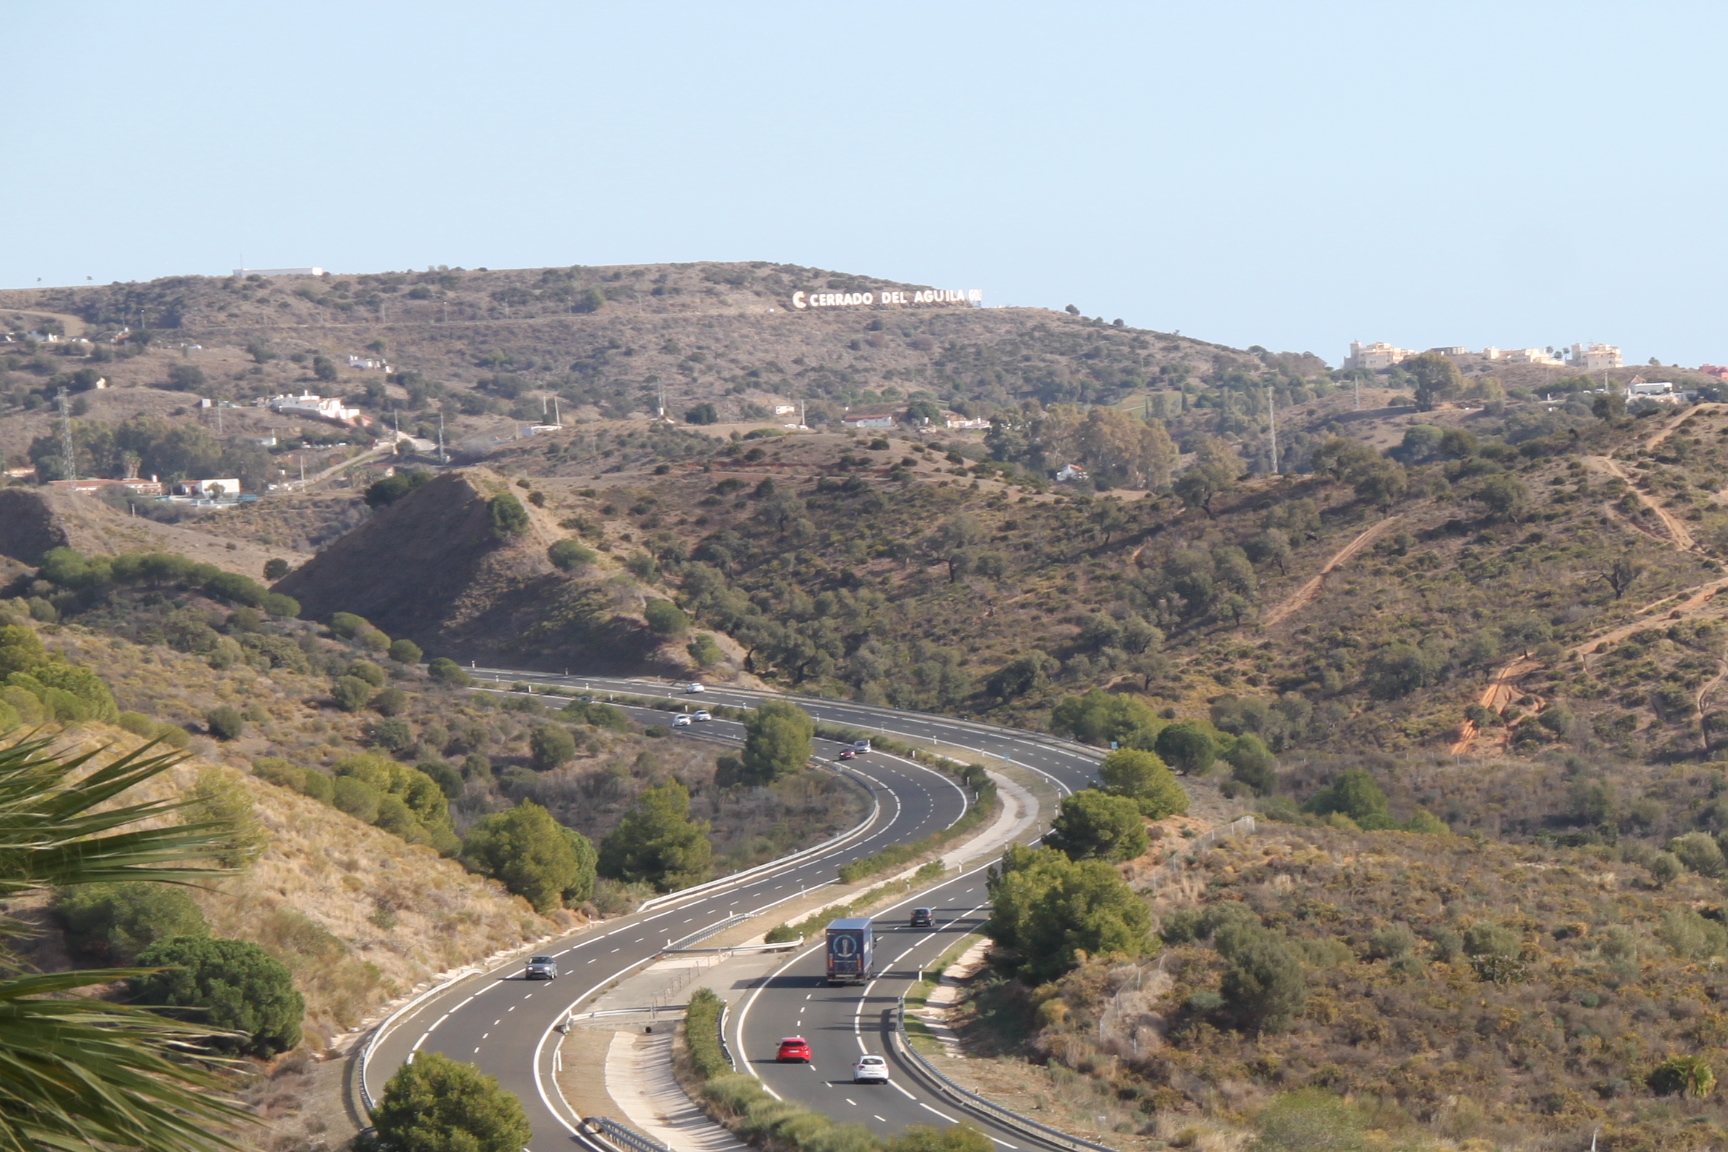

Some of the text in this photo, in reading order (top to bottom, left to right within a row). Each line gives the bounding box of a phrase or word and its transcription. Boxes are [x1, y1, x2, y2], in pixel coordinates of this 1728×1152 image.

[810, 293, 873, 306] CERRADO
[881, 292, 907, 304] DEL
[914, 289, 965, 303] AGUILA
